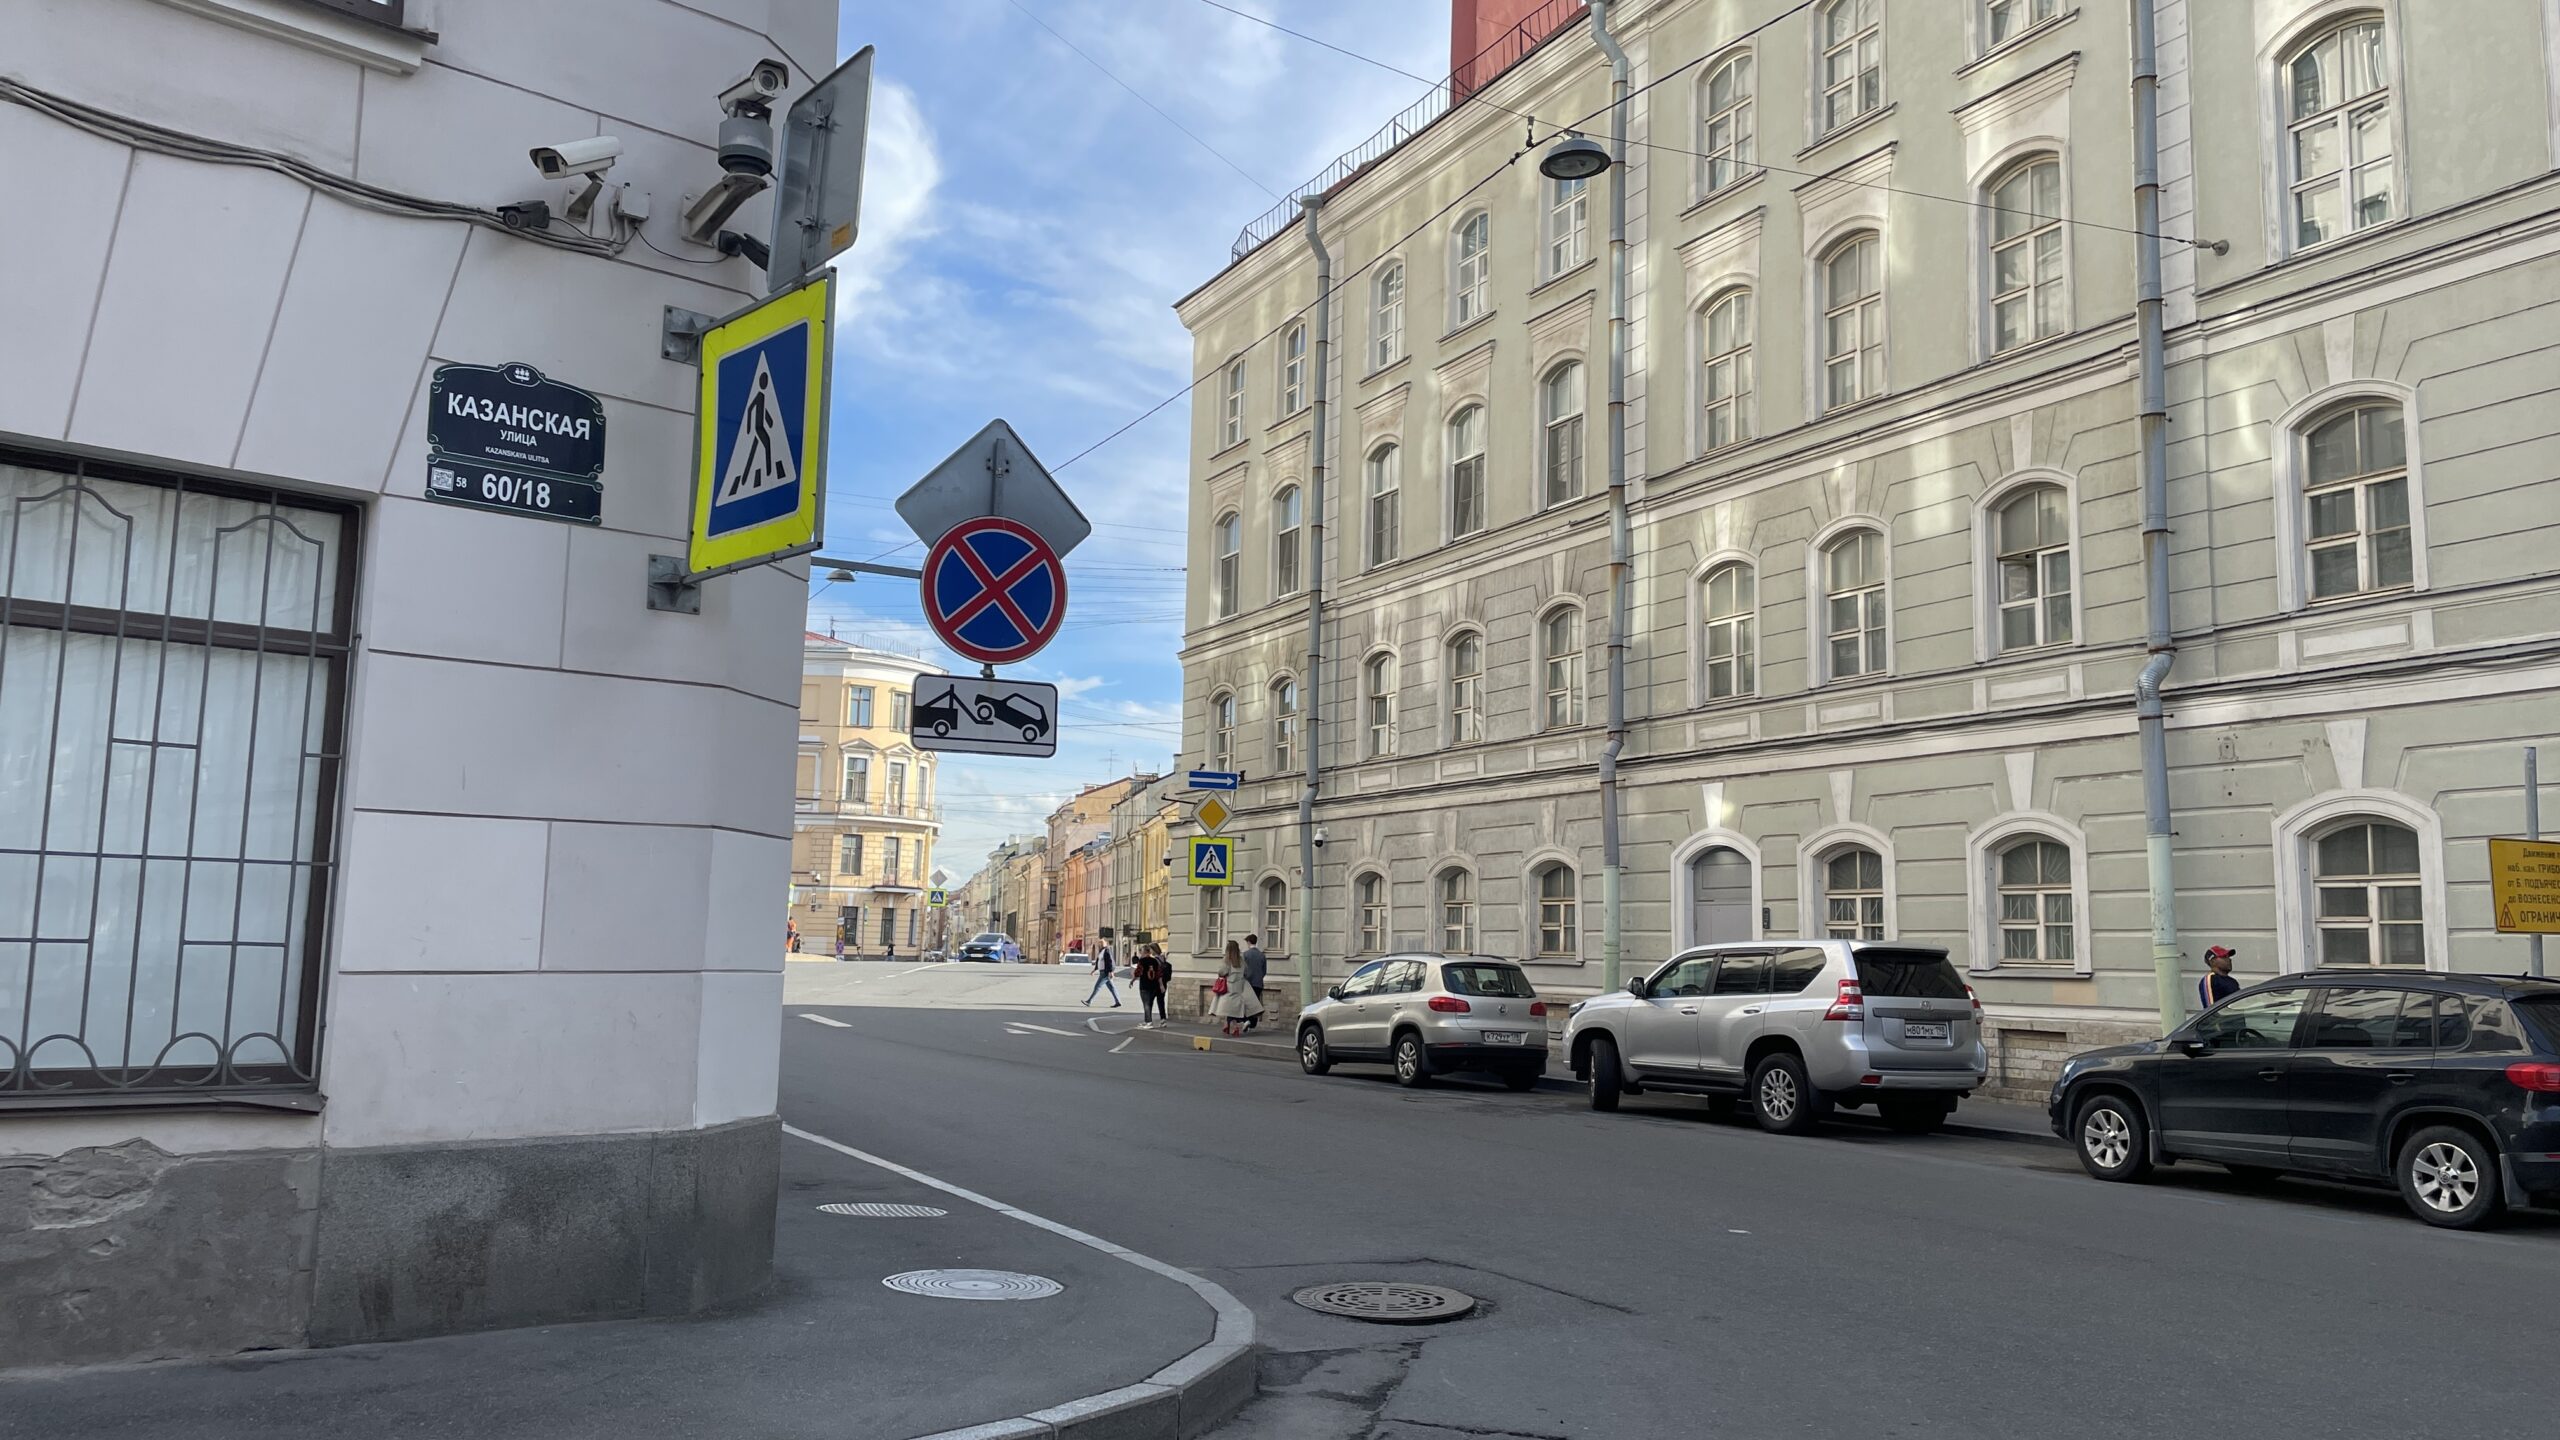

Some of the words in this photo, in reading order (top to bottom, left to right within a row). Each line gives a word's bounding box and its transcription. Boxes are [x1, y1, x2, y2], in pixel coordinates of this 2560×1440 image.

[448, 392, 590, 440] КАЗАНСКАЯ
[500, 429, 537, 446] УЛИЦА
[485, 446, 527, 461] KAZANSKAYA
[528, 453, 550, 464] ULITSA
[456, 476, 467, 488] 58
[482, 473, 551, 508] 60/18
